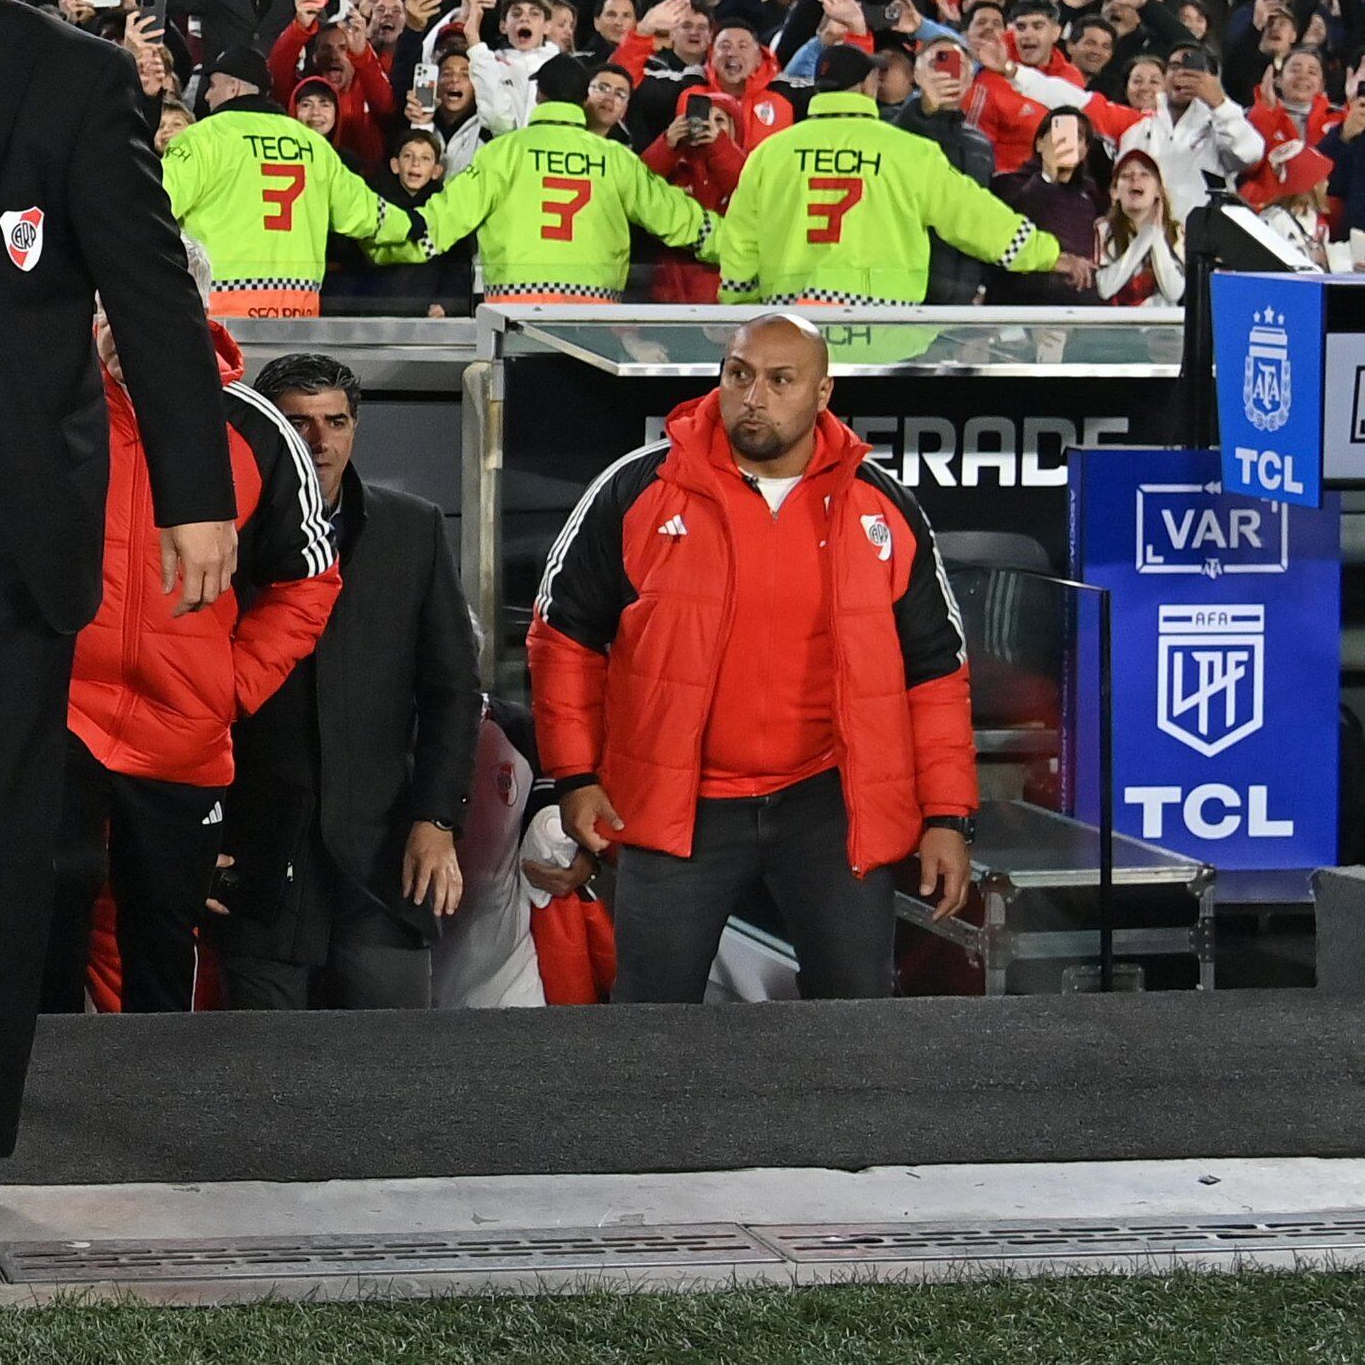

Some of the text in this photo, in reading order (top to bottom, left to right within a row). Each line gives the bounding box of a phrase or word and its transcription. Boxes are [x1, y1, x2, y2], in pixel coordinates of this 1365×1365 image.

[242, 135, 314, 163] TECH
[527, 148, 607, 178] TECH
[792, 147, 883, 178] TECH
[1234, 446, 1304, 495] TCL
[1161, 509, 1262, 549] VAR
[1194, 611, 1228, 626] AFA
[1124, 783, 1293, 840] TCL
